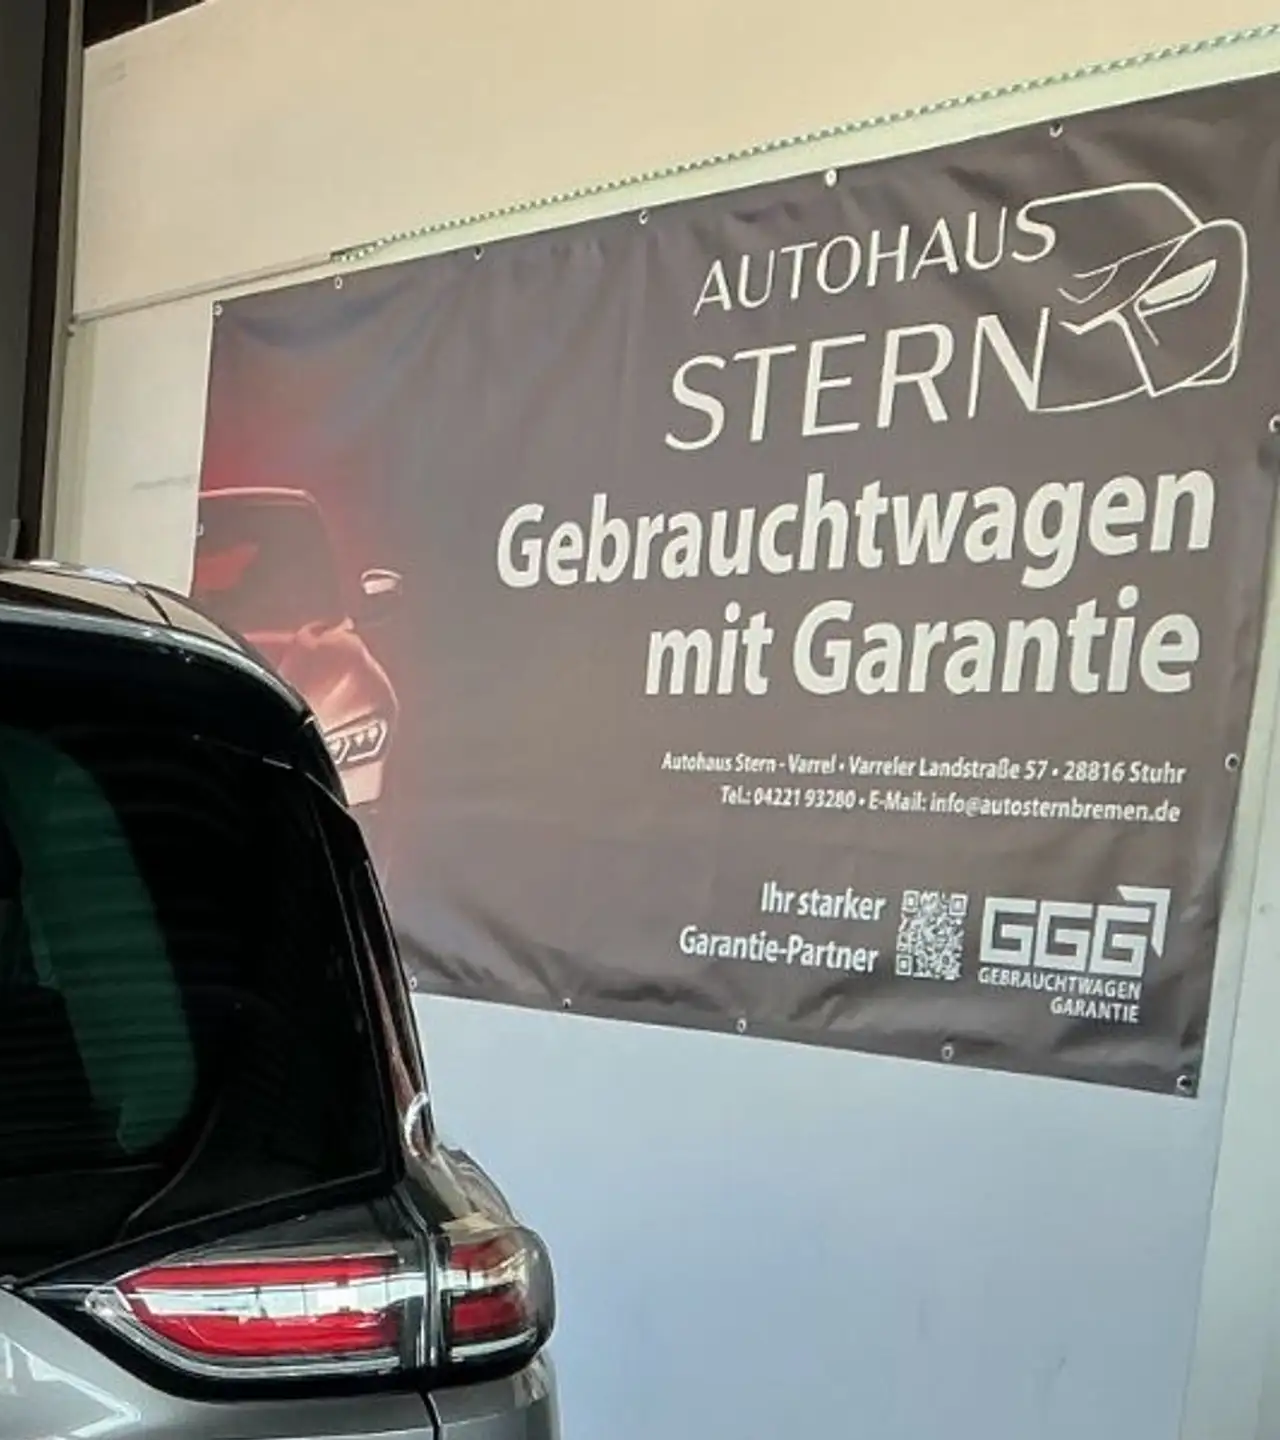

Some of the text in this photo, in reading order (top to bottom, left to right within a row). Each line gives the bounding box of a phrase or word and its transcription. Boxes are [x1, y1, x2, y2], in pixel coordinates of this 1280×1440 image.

[693, 200, 1057, 316] AUTOHAUS
[664, 307, 1051, 450] STERN
[497, 466, 1216, 588] Gebrauchtwagen
[645, 586, 1200, 696] mit Garantie
[661, 751, 732, 772] Autohaus
[735, 754, 776, 773] Stern
[788, 754, 837, 775] Varrel
[849, 754, 916, 776] Varreler
[919, 756, 1021, 779] Landstraße
[1023, 760, 1048, 780] 57
[1064, 760, 1125, 783] 28816
[1128, 761, 1187, 784] Stuhr
[753, 787, 800, 807] 04221
[804, 789, 856, 809] 93280
[867, 790, 926, 812] E-Mail:
[930, 792, 1181, 822] info@autosternbremen.de
[761, 880, 887, 920] Ihr starker
[679, 924, 880, 973] Garantie-Partner
[979, 897, 1151, 977] GGG
[978, 967, 1142, 1000] GEBRAUCHTWAGEN
[1050, 996, 1140, 1023] GARANTIE
